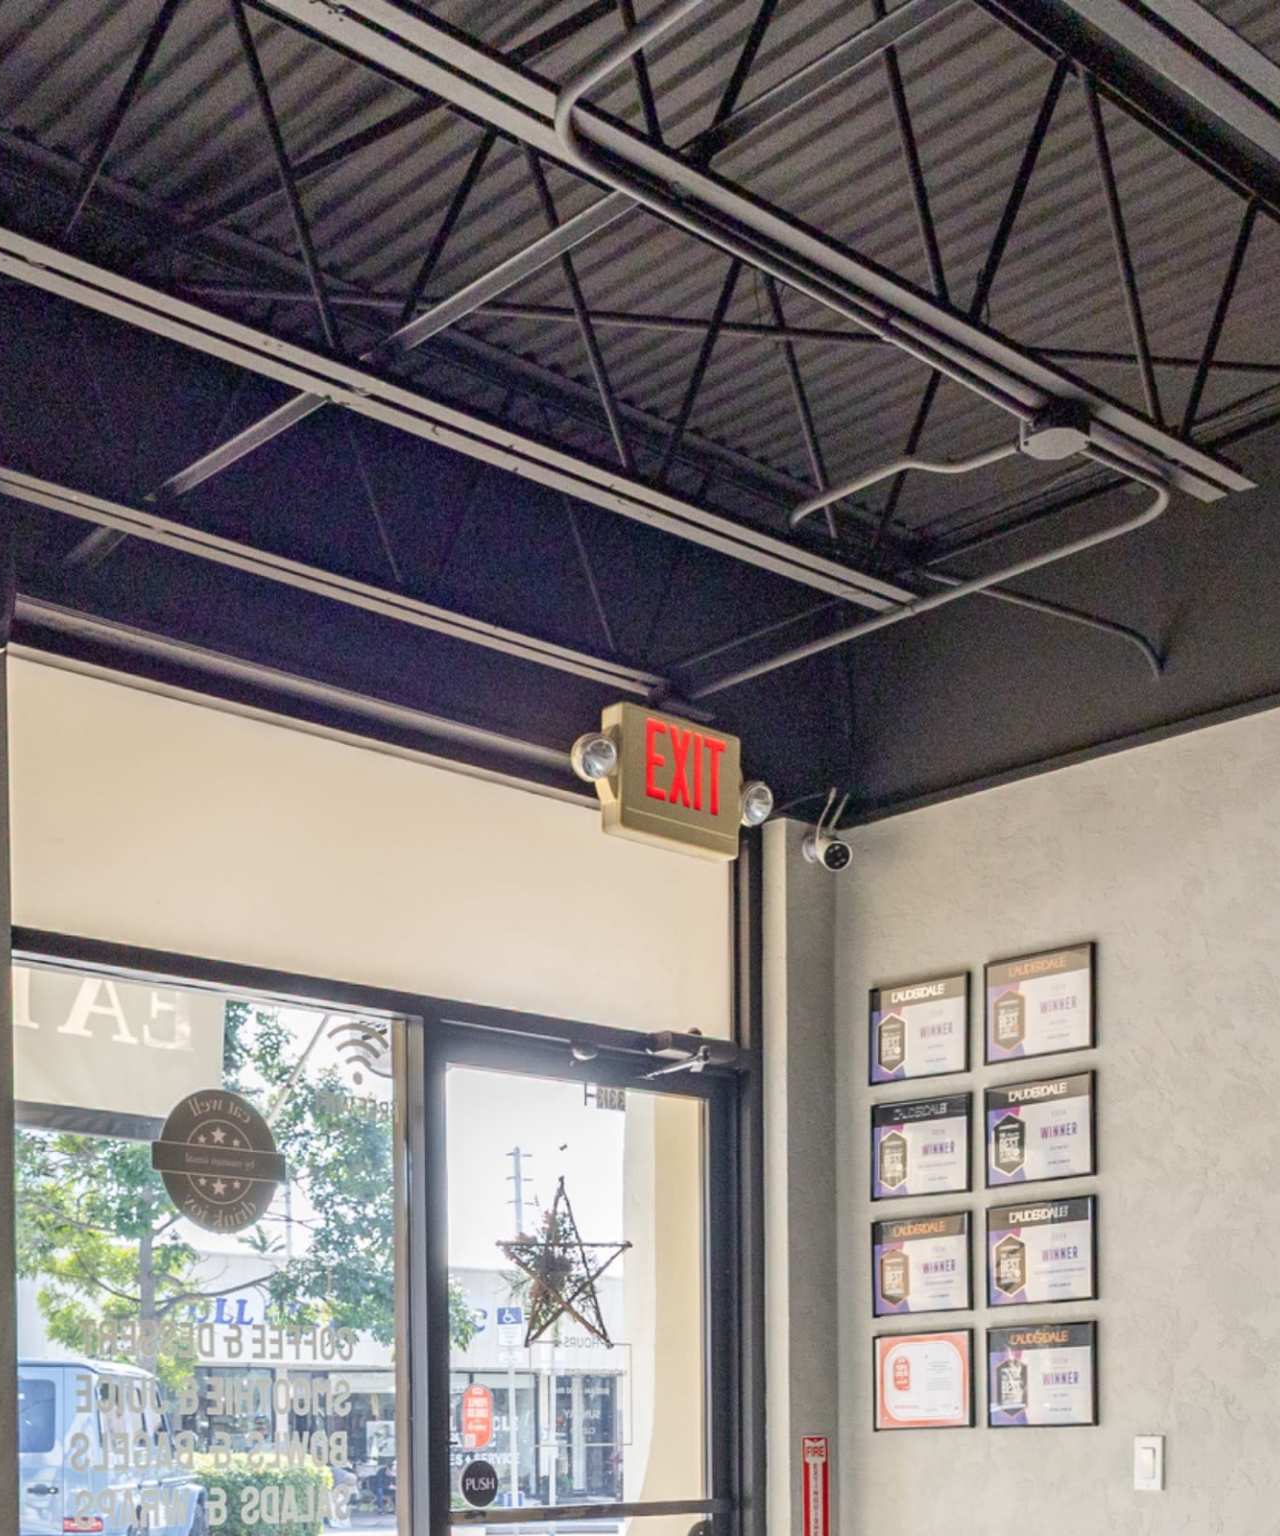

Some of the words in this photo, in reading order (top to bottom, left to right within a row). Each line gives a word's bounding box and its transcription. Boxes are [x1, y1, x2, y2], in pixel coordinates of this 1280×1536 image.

[646, 716, 727, 816] EXIT
[1040, 1121, 1078, 1139] WINNER
[465, 1478, 496, 1492] PUSH
